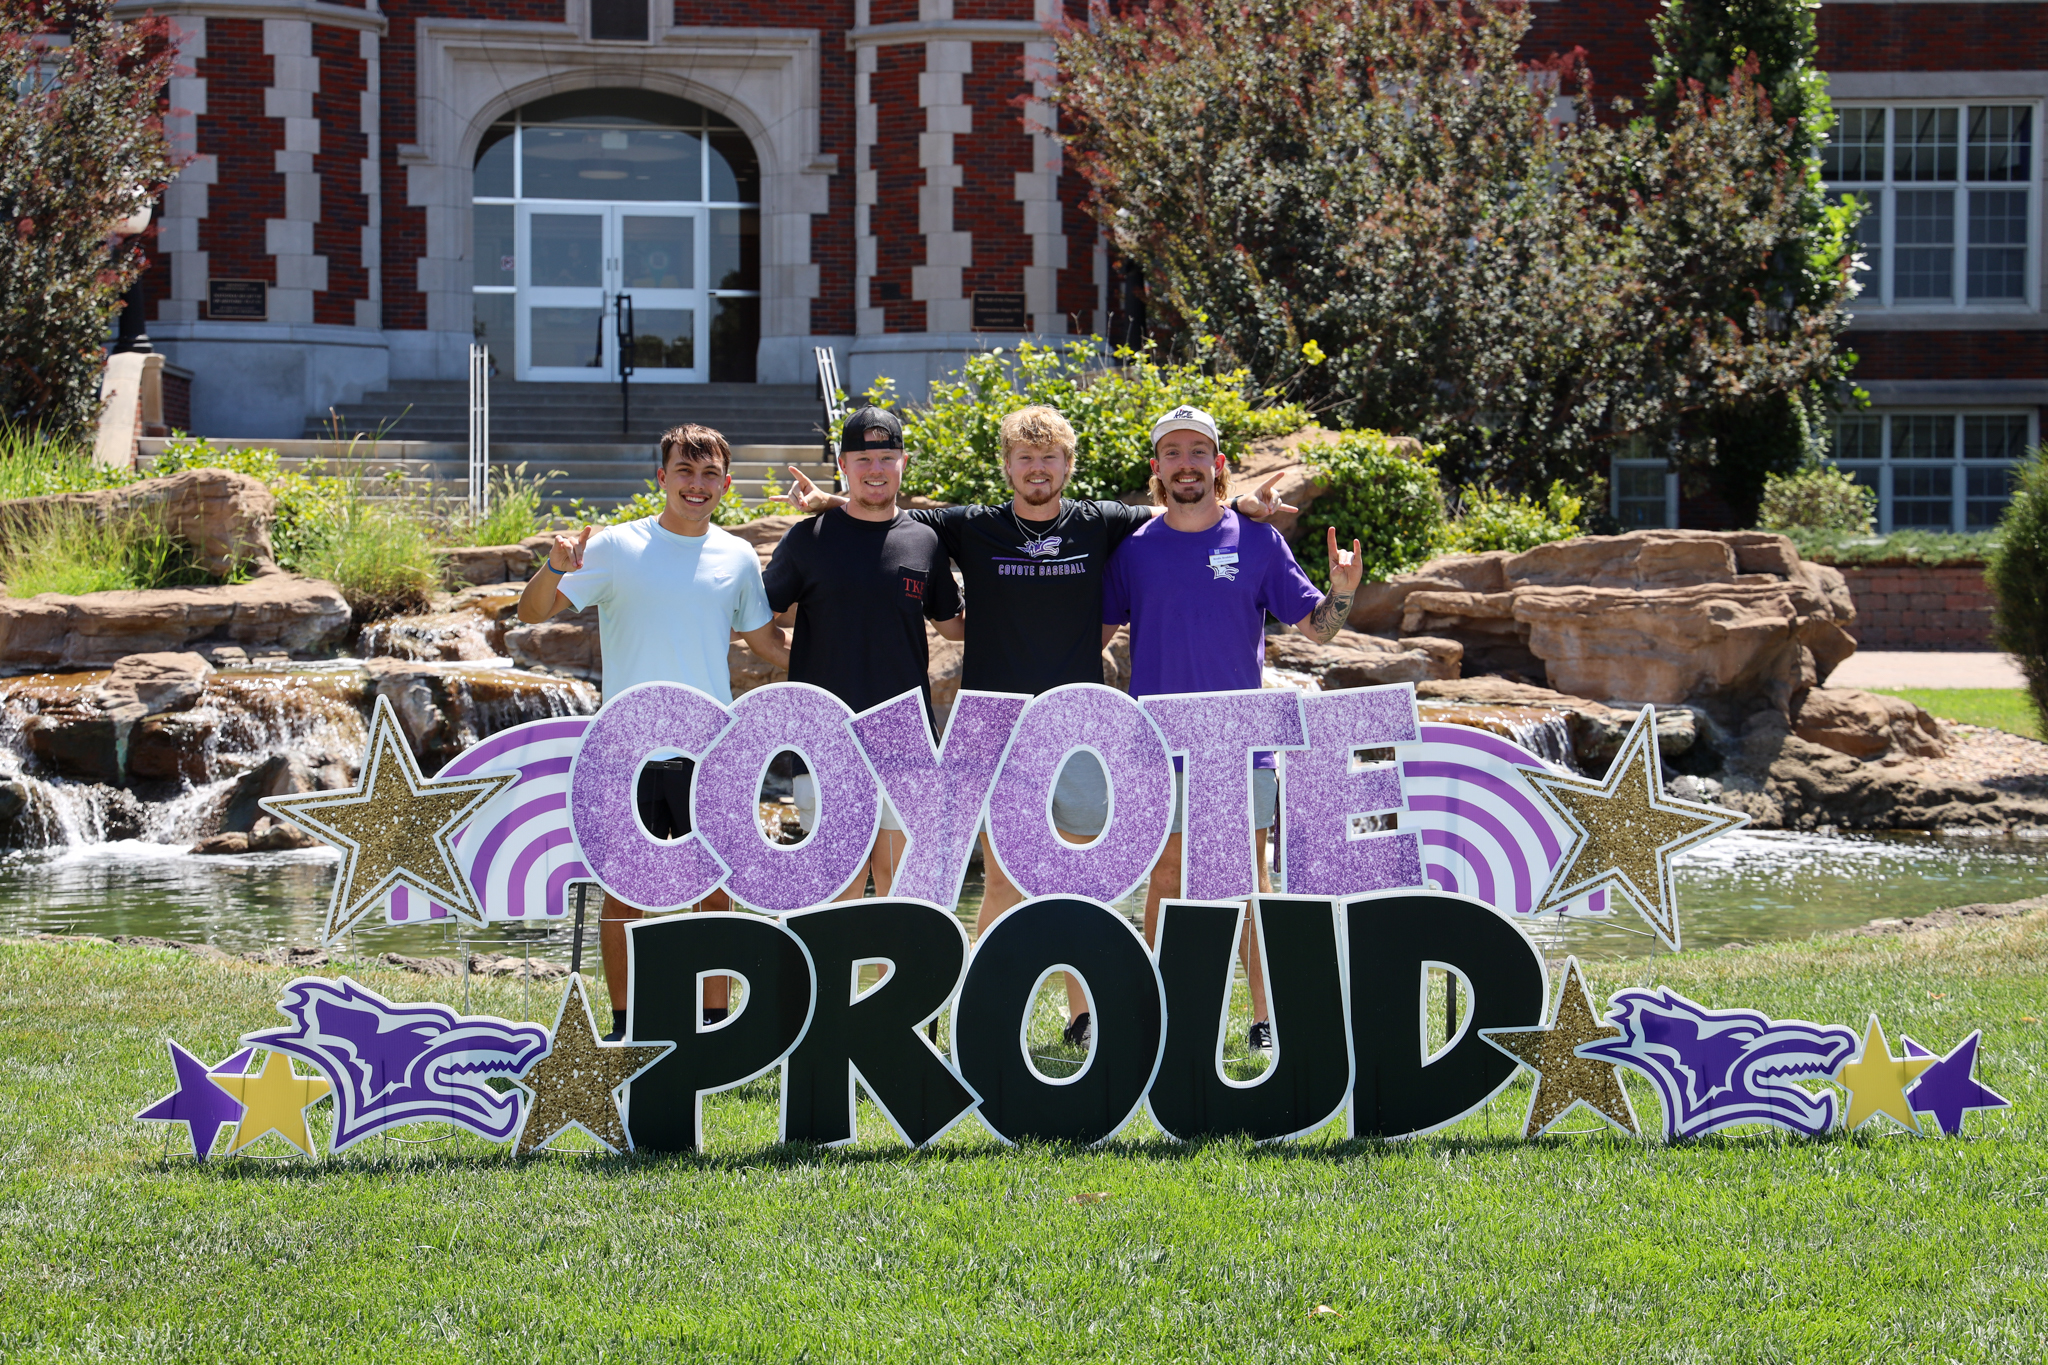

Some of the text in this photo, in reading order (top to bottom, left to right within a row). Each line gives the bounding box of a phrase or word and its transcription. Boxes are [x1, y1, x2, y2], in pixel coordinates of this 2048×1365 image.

[998, 562, 1086, 576] COYOTE BASEBALL
[567, 681, 1429, 911] COYOTE
[624, 893, 1549, 1152] PROUD
